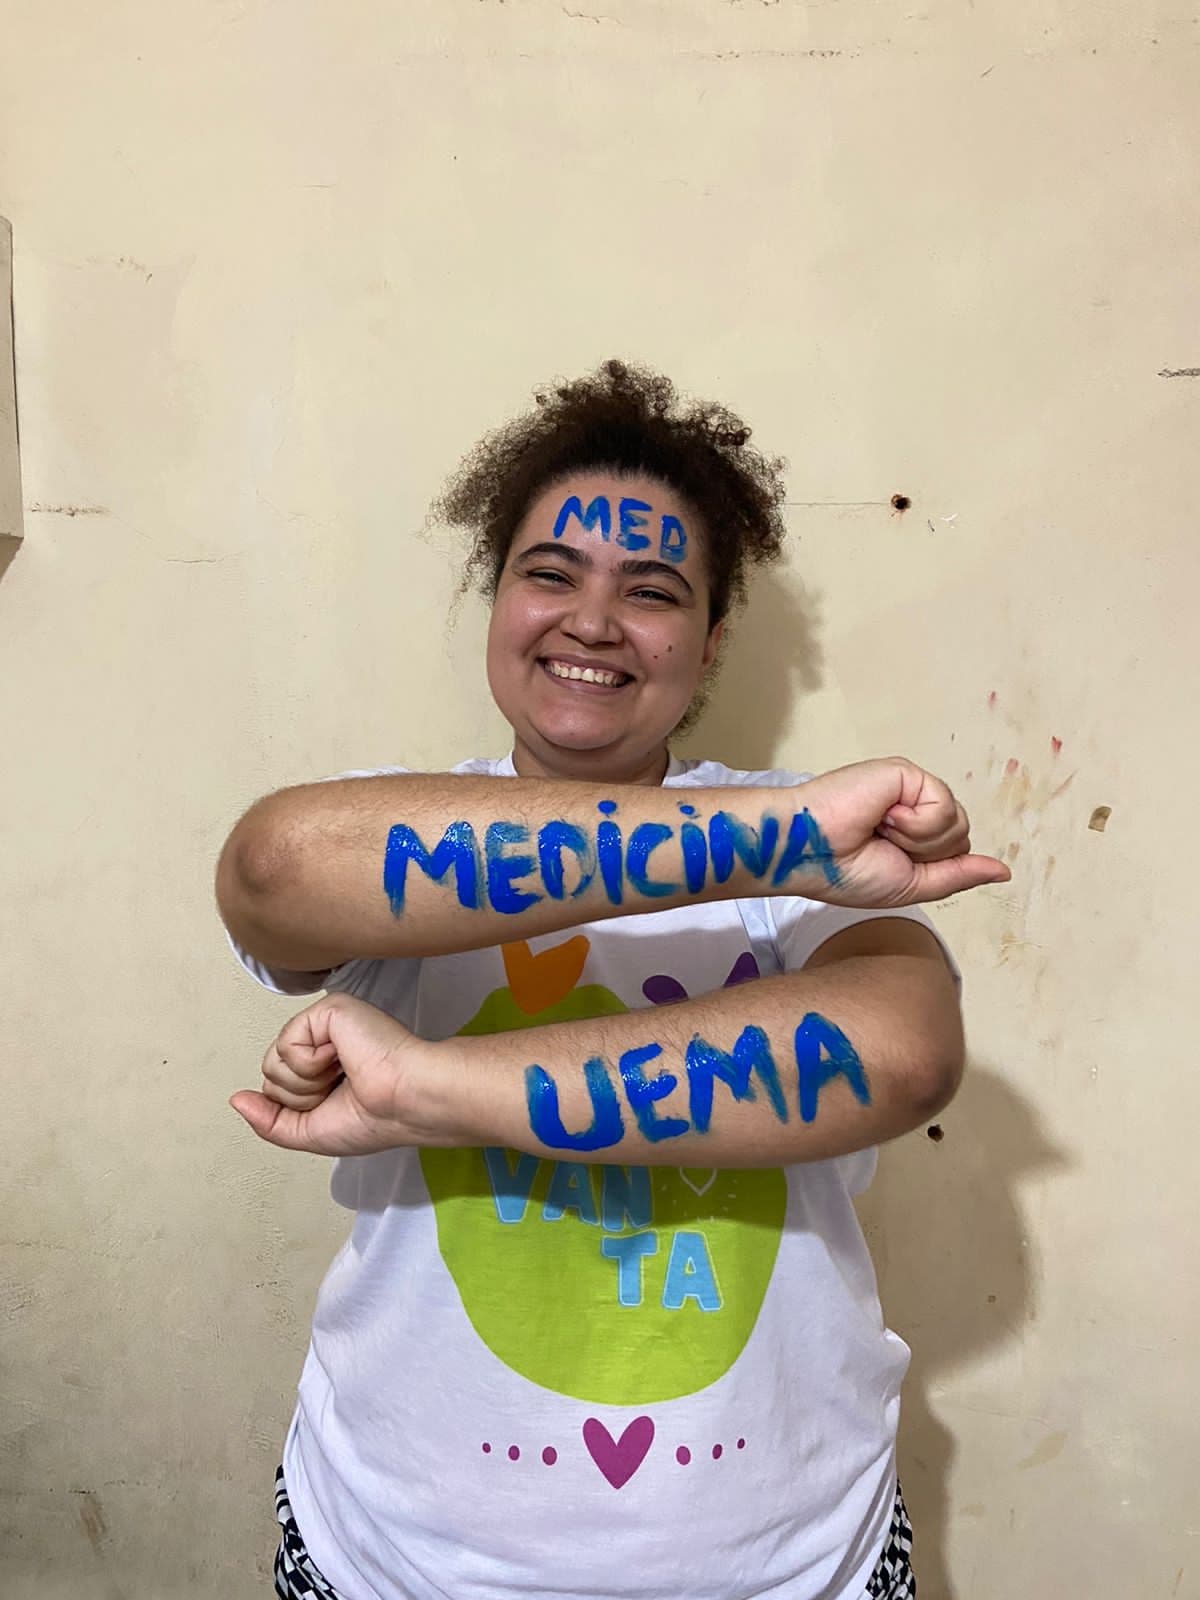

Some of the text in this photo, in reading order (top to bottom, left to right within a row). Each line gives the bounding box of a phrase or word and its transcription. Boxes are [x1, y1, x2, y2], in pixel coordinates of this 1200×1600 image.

[553, 495, 687, 564] MED
[525, 1012, 871, 1151] UEMA
[601, 1228, 724, 1312] TA
